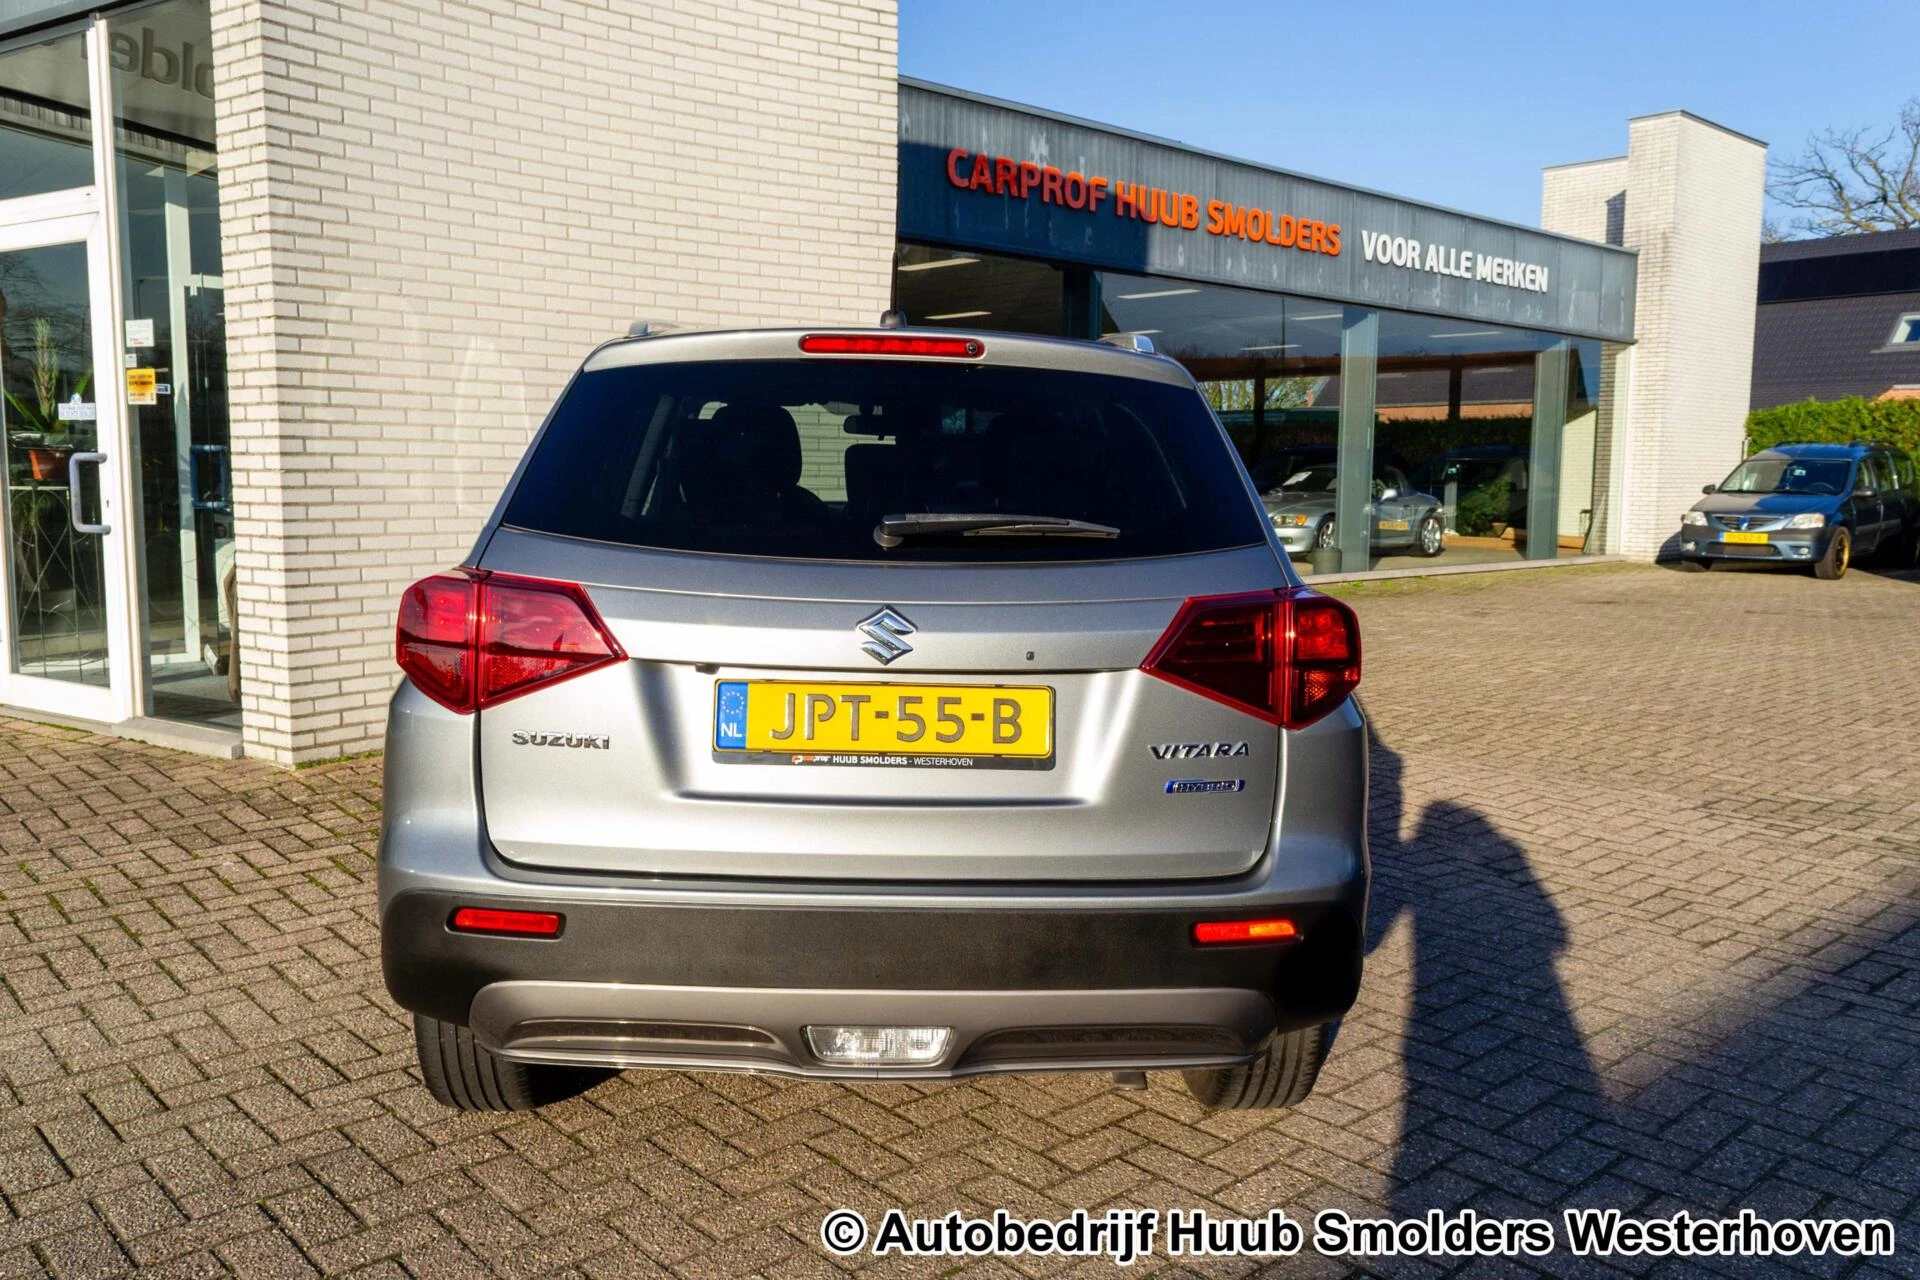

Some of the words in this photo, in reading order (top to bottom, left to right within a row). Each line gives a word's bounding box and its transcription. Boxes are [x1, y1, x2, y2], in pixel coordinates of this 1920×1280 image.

[947, 148, 1108, 212] CARPROF
[1116, 180, 1199, 230] HUUB
[1207, 199, 1342, 256] SMOLDERS
[1361, 230, 1421, 270] VOOR
[1424, 244, 1473, 279] ALLE
[1476, 254, 1549, 293] MERKEN
[768, 692, 1023, 744] JPT-55-B
[512, 729, 610, 750] SUZUKI
[720, 723, 742, 738] NL
[832, 755, 858, 764] HUUB
[859, 755, 908, 765] SMOLDERS
[913, 757, 974, 767] WESTERHOVEN
[1147, 741, 1250, 760] VITARA
